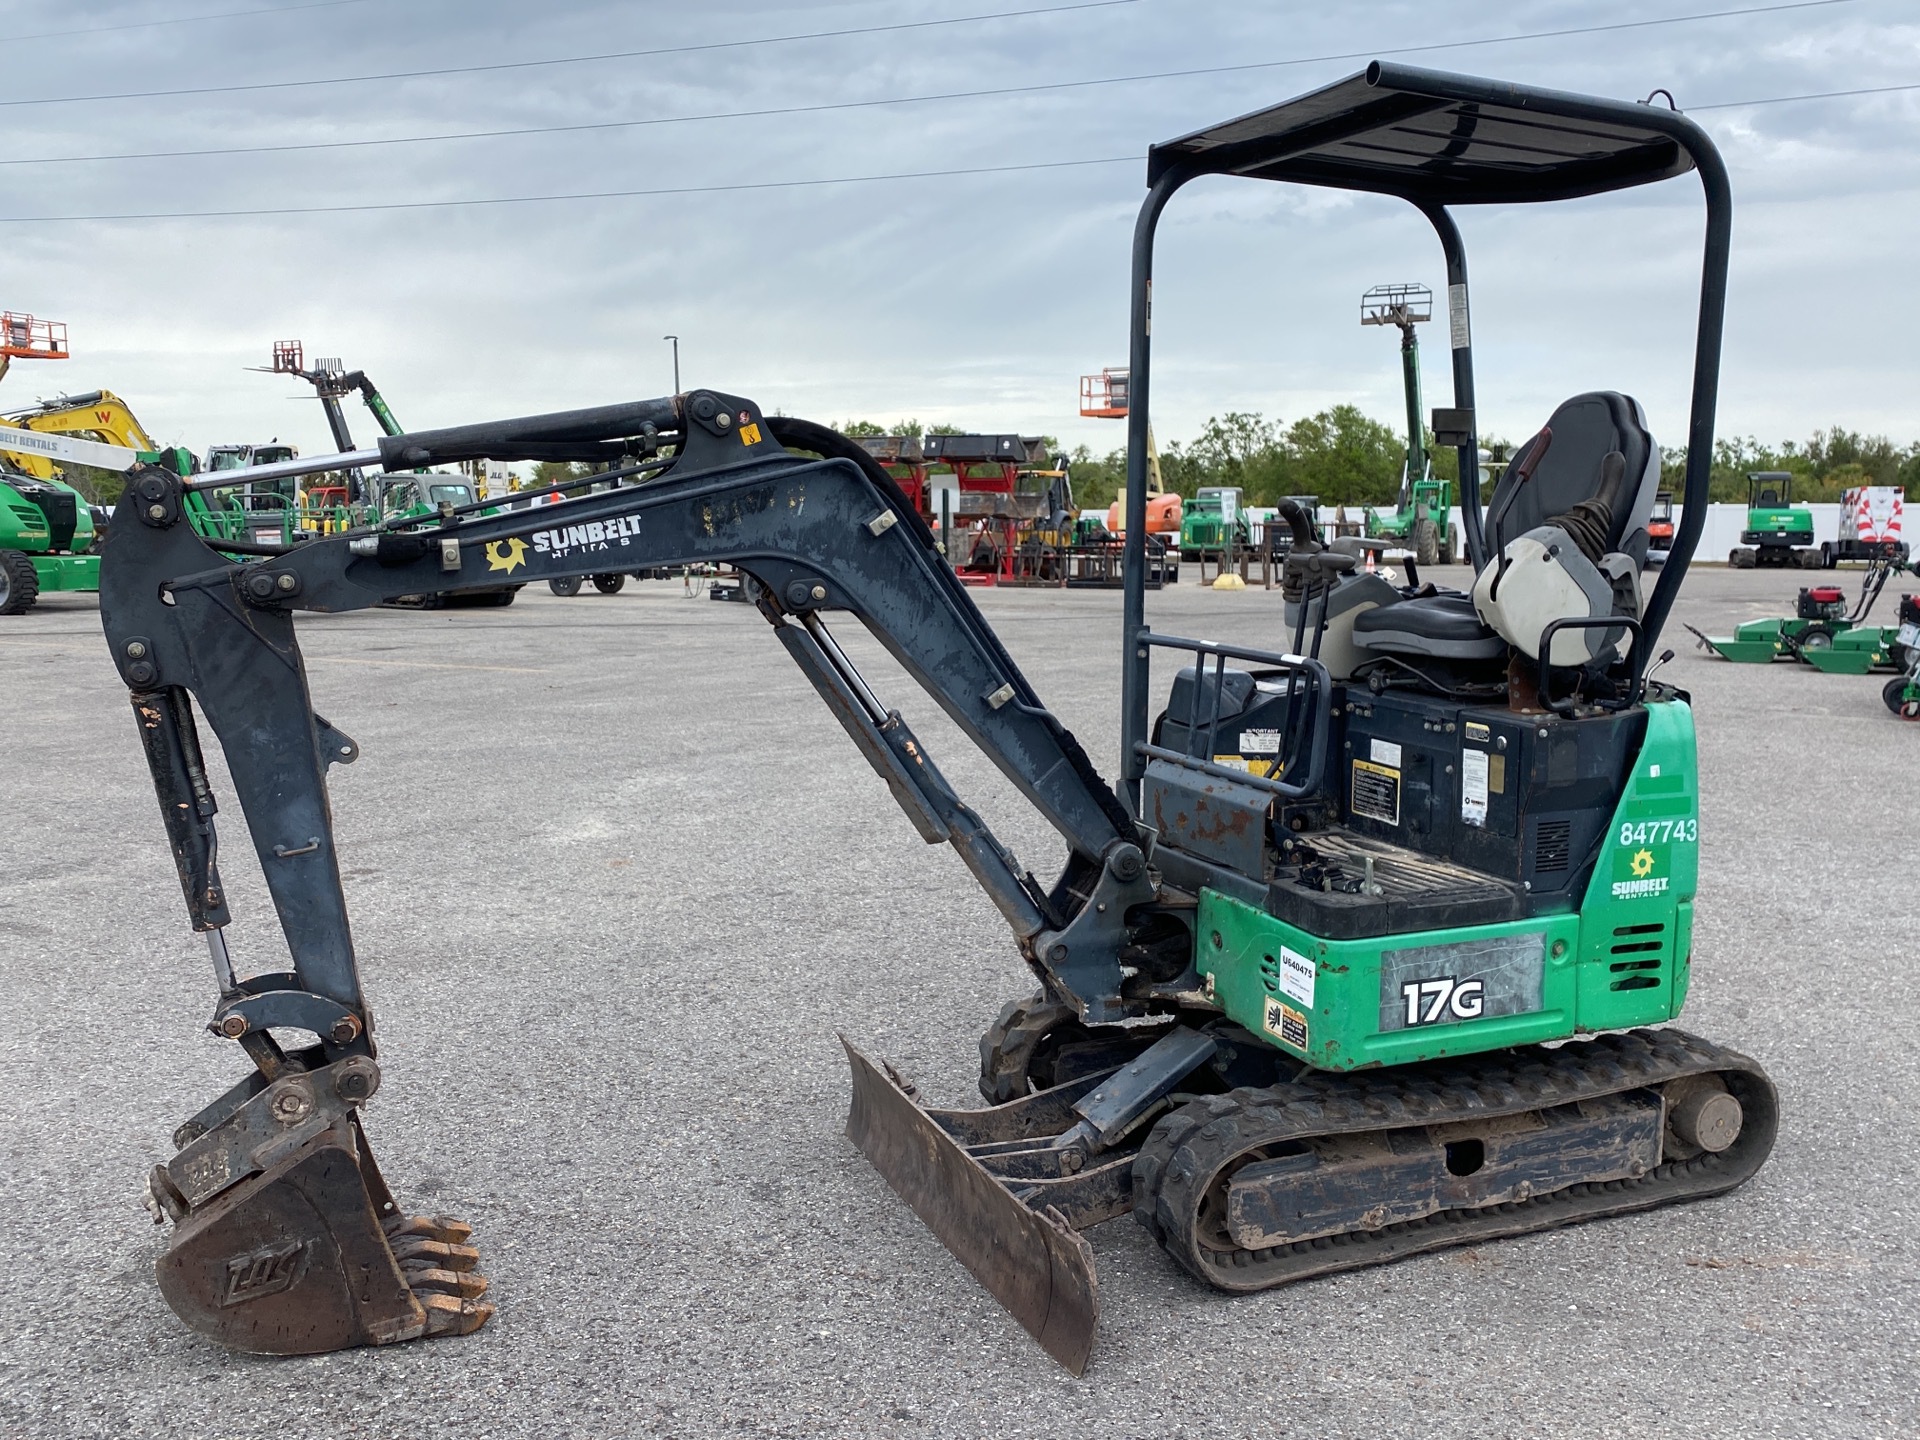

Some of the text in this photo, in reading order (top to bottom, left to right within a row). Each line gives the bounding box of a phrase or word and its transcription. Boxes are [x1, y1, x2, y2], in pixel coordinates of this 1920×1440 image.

[20, 436, 58, 451] RENTALS
[532, 514, 641, 553] SUNBELT
[552, 537, 630, 559] RETAS
[1620, 819, 1697, 846] 847743
[1611, 877, 1669, 896] SUNBELT
[1618, 891, 1660, 900] RENTALS
[1282, 955, 1313, 978] U640475
[1403, 978, 1483, 1026] 17G
